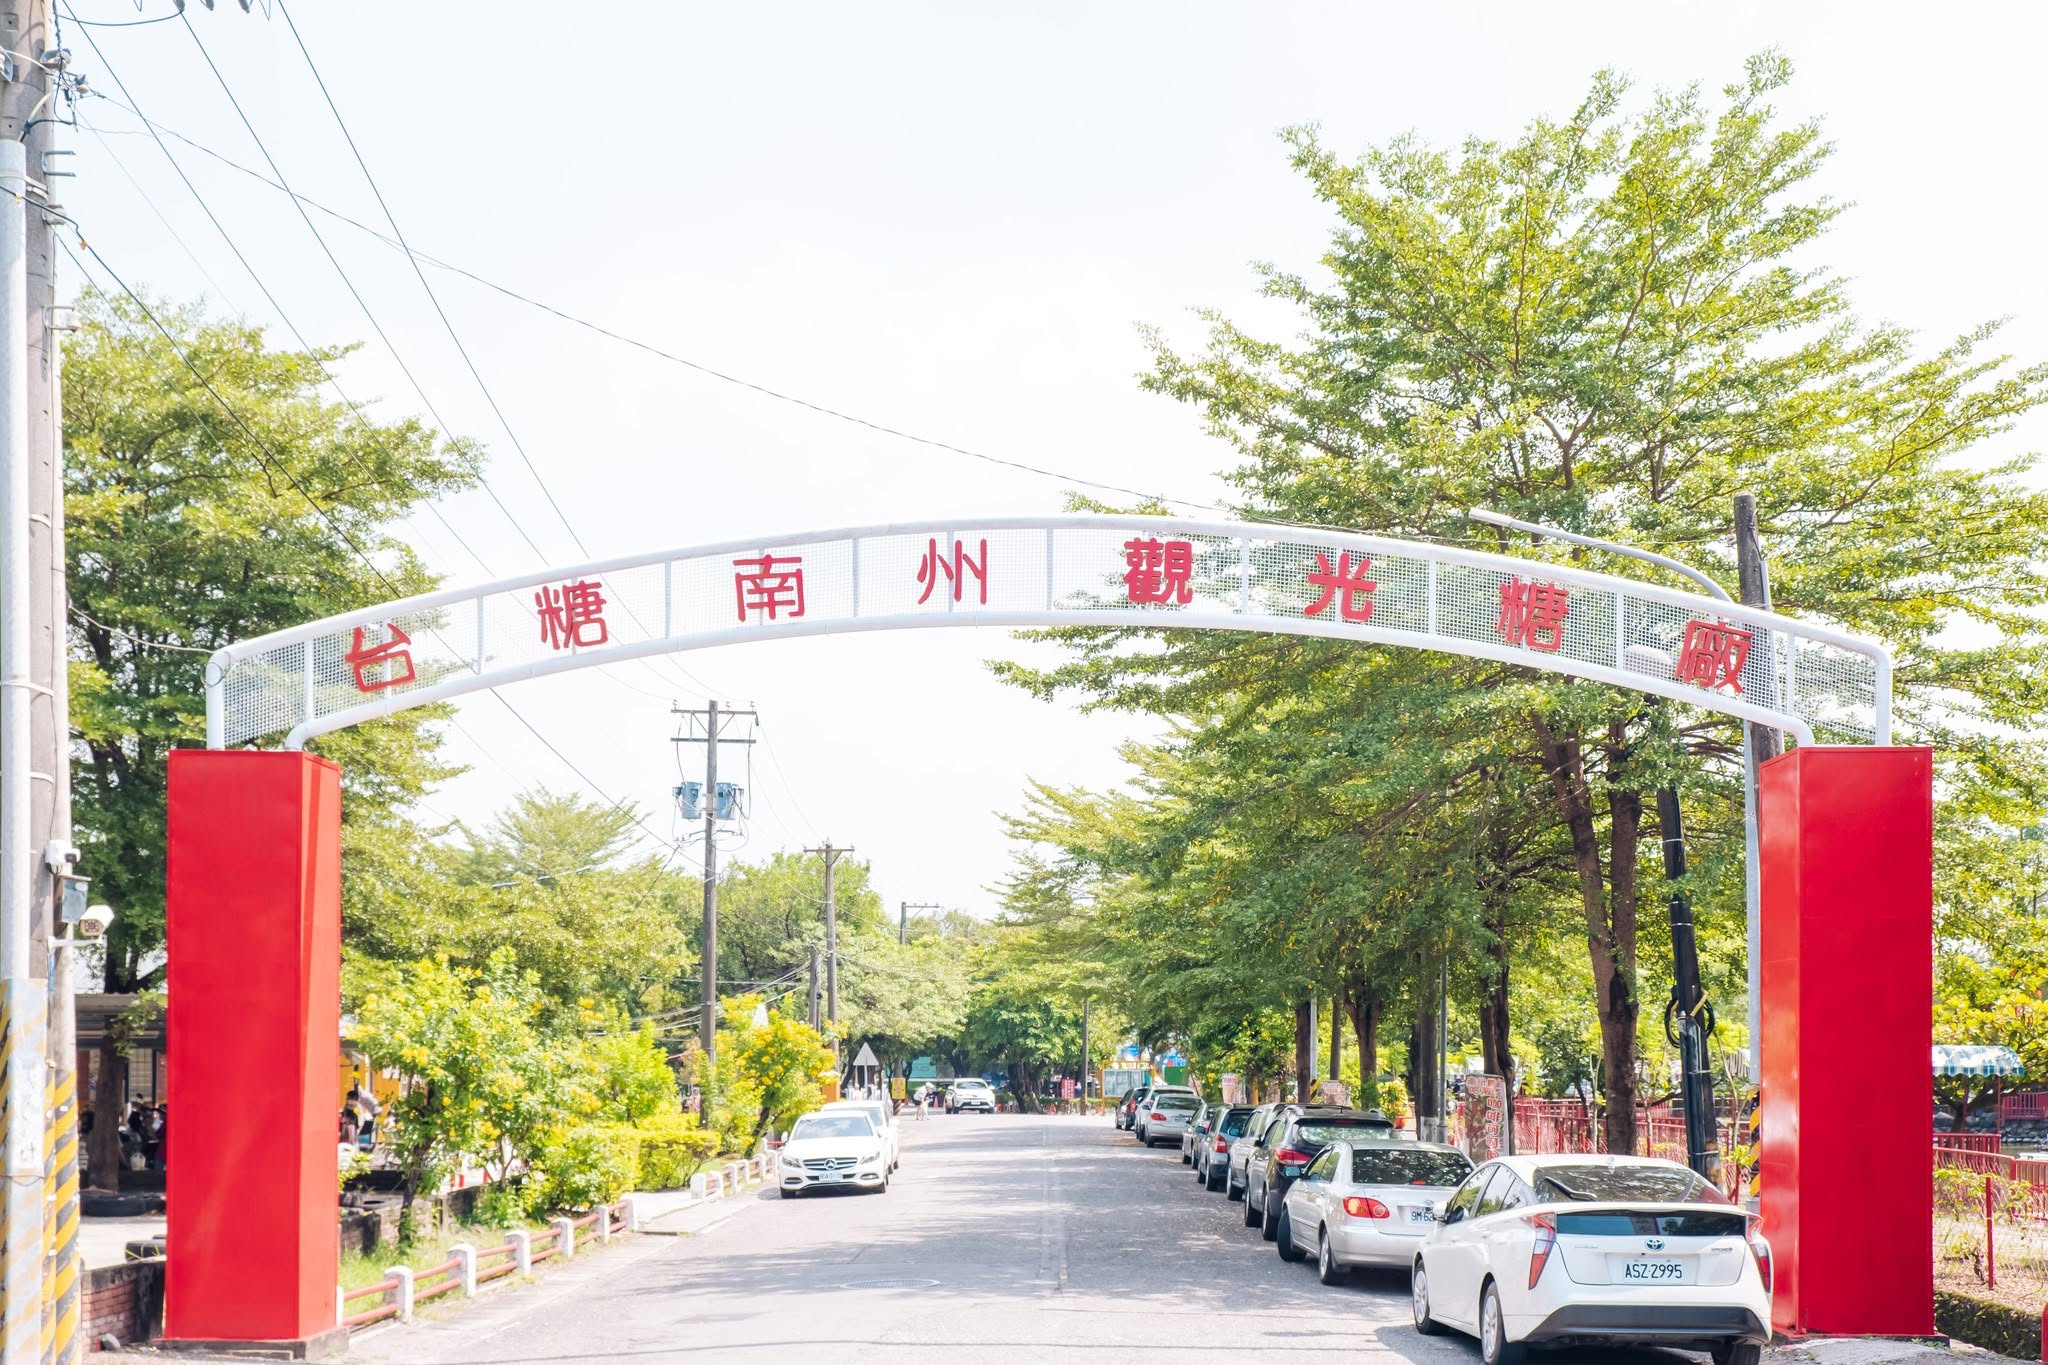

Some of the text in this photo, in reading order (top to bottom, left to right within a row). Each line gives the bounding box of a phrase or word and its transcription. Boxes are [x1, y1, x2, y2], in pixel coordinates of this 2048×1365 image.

[346, 538, 1754, 693] 台糖南州觀光糖廠
